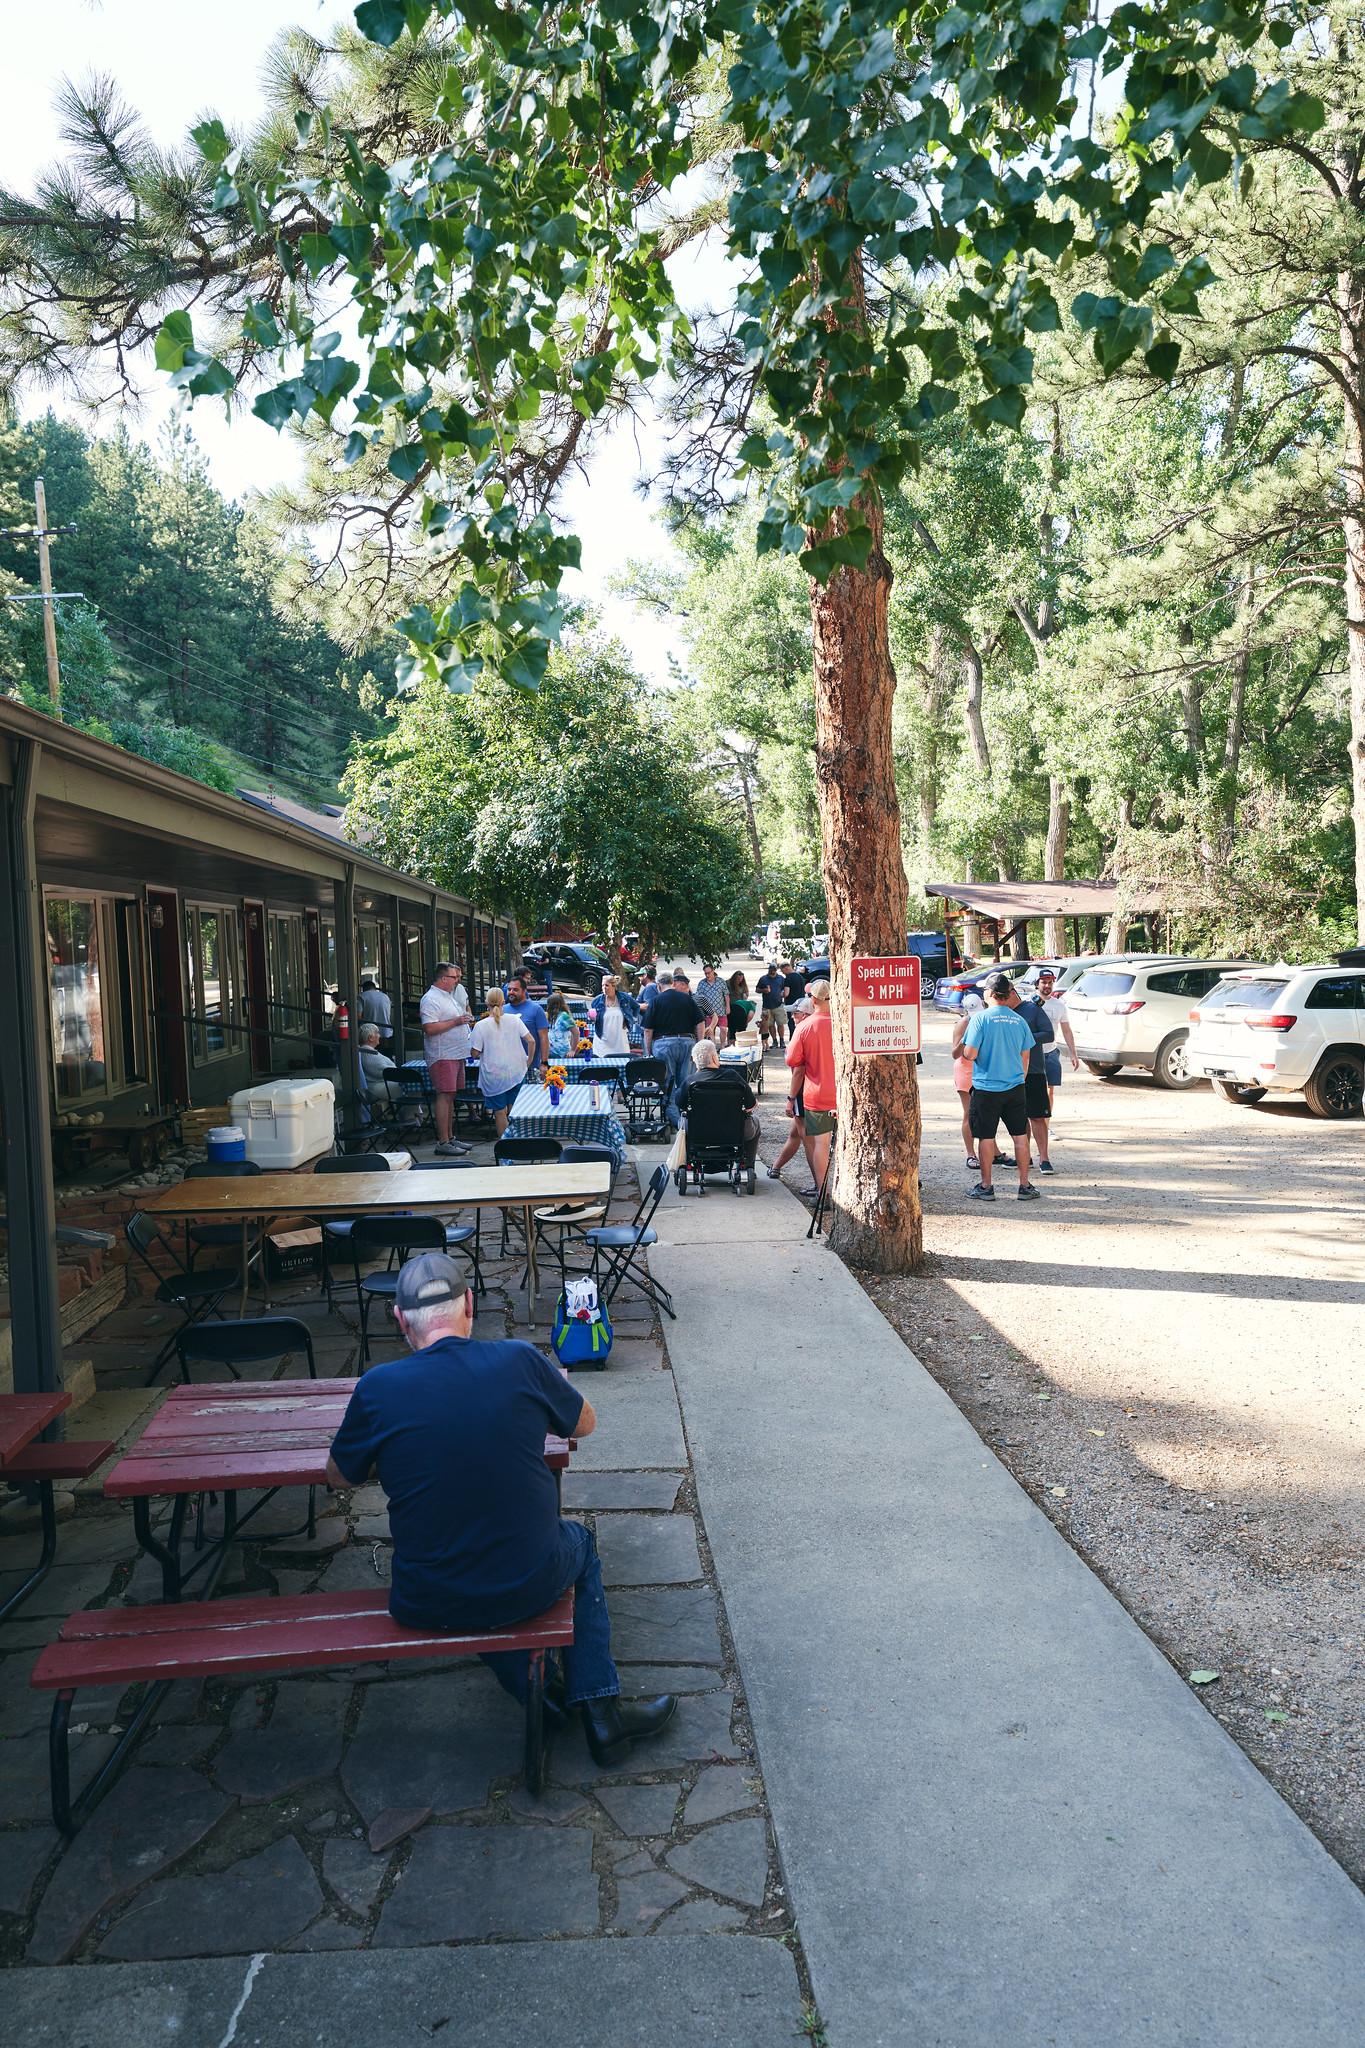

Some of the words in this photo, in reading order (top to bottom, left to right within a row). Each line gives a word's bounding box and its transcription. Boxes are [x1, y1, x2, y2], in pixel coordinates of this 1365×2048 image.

[858, 964, 885, 981] Speed
[889, 964, 914, 977] Limit
[867, 985, 874, 1000] 3
[879, 984, 903, 999] MPH
[869, 1010, 890, 1020] Watch
[893, 1010, 903, 1020] for
[860, 1038, 875, 1047] kids
[877, 1037, 890, 1047] and
[893, 1036, 912, 1048] dogs!
